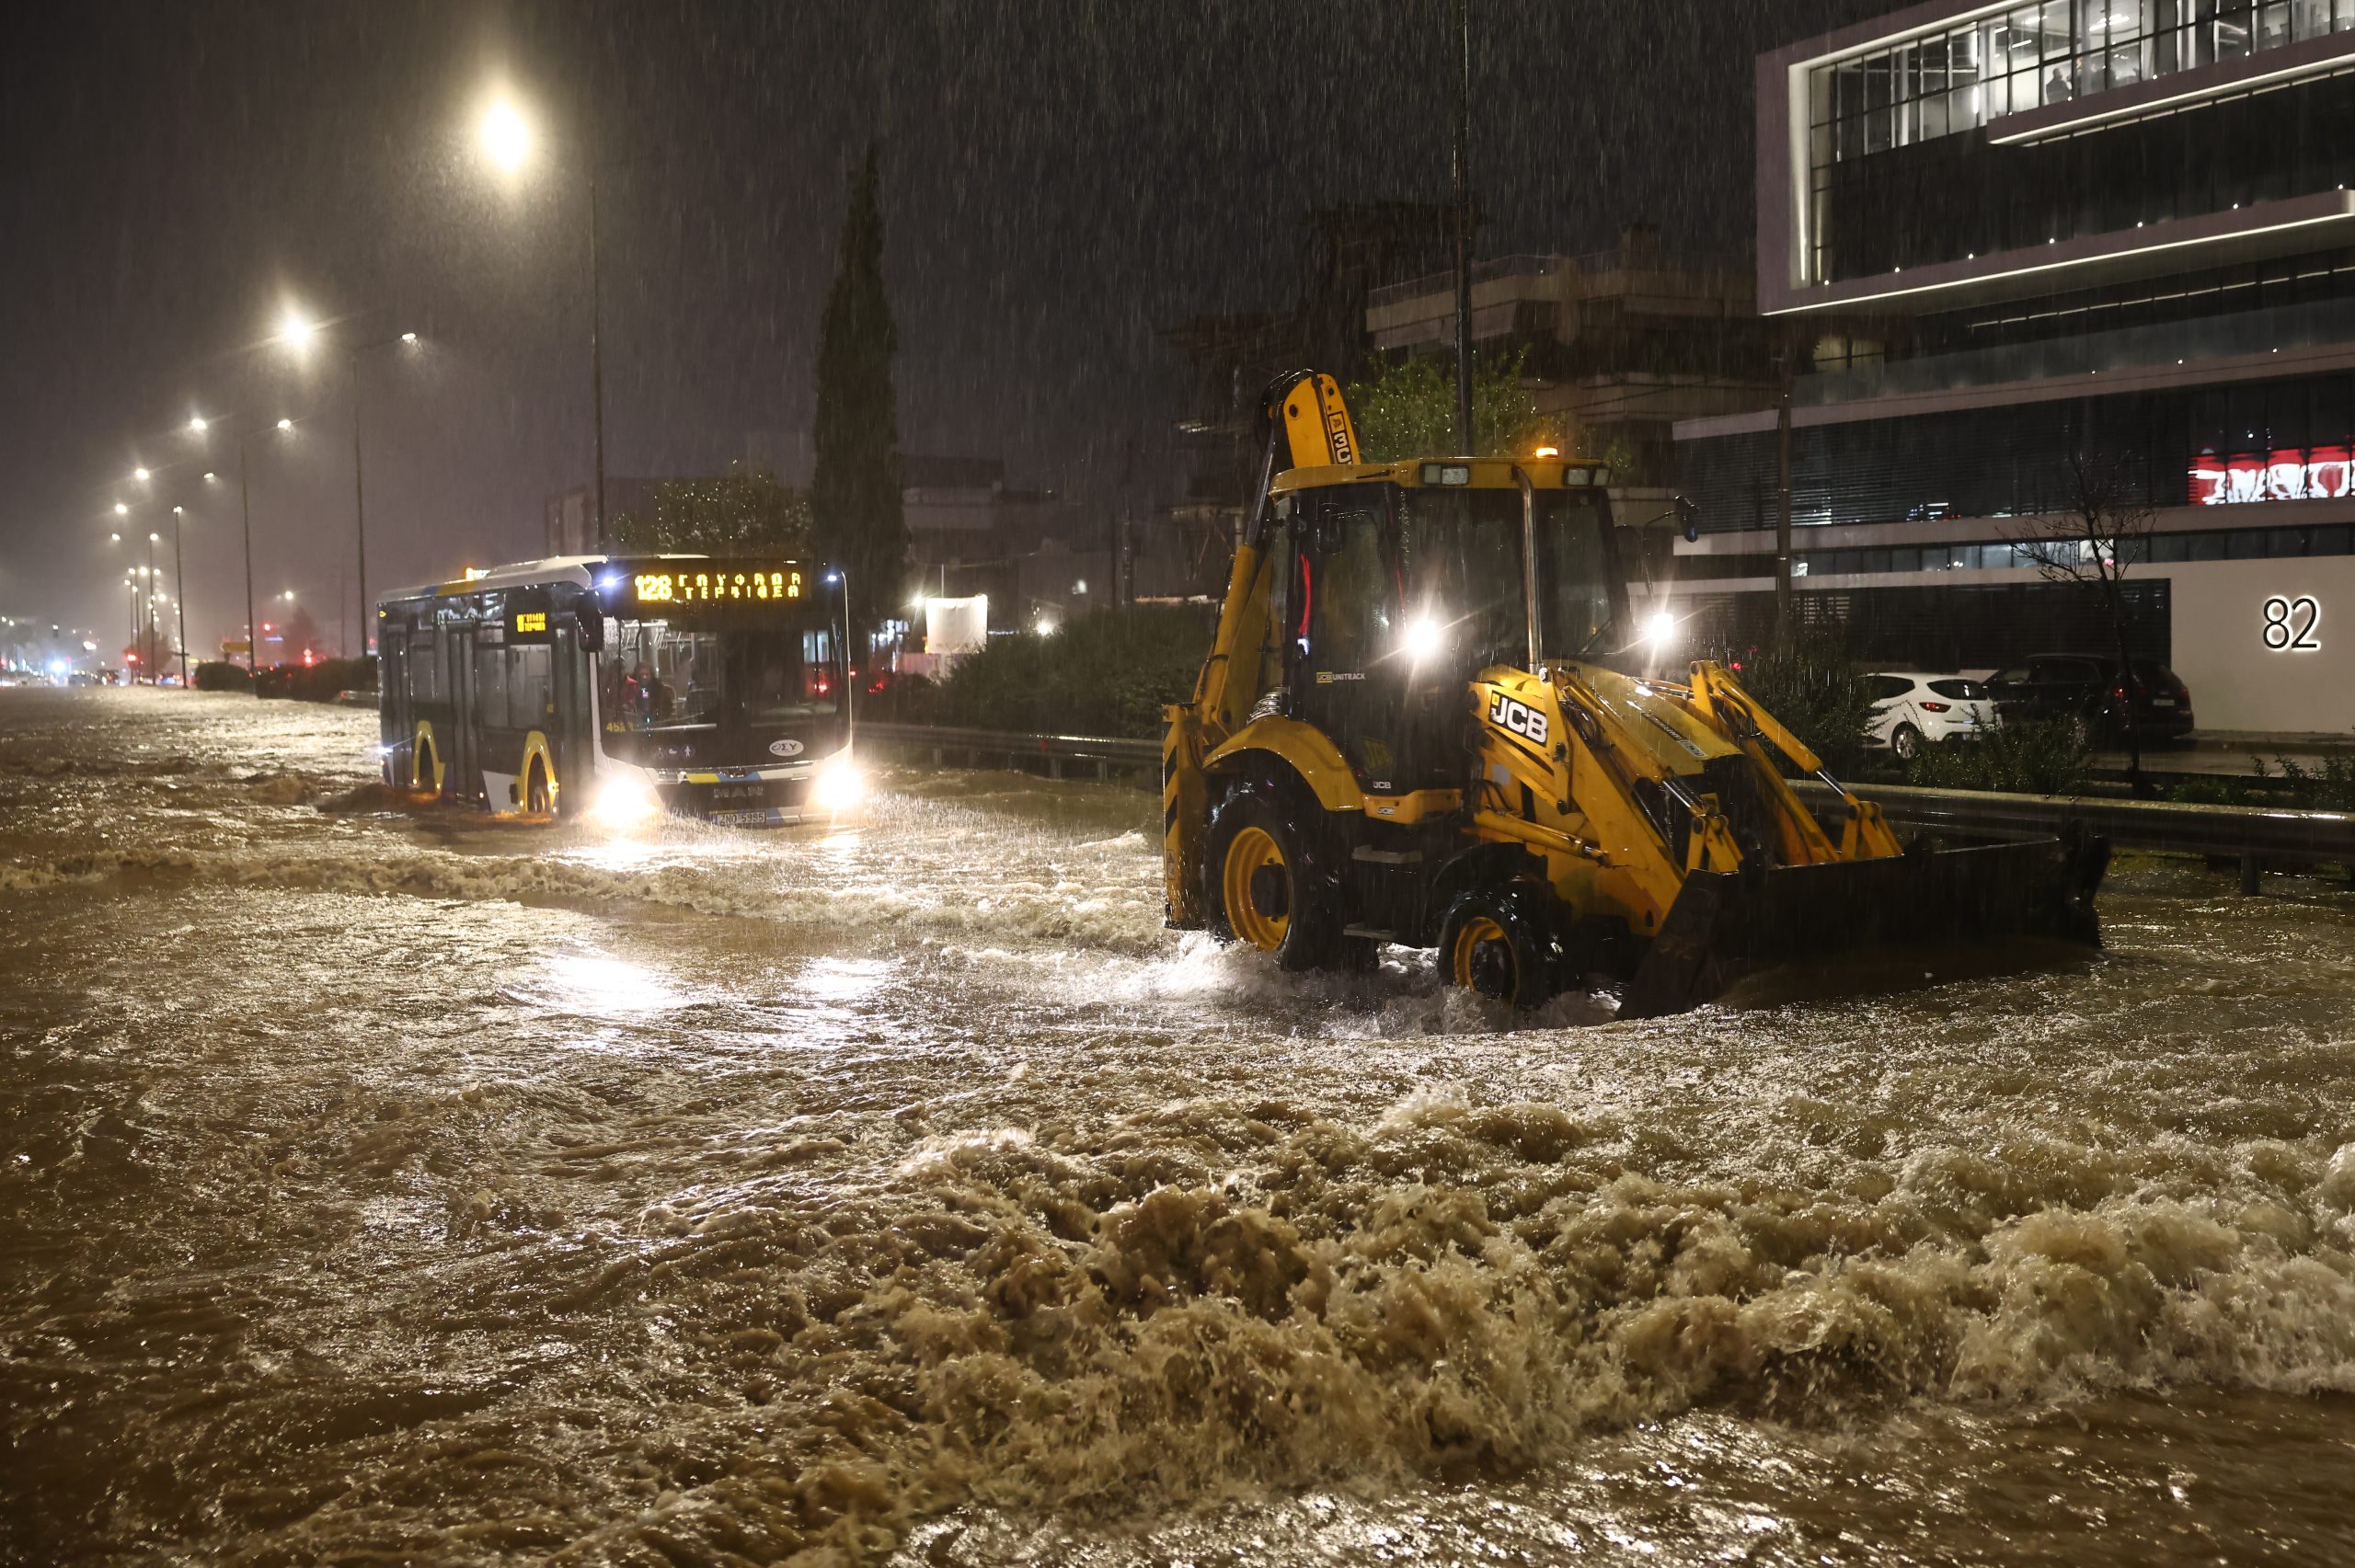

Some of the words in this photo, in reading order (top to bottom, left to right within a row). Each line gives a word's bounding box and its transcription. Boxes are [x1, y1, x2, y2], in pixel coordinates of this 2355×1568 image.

[1333, 432, 1352, 464] 3C
[635, 575, 672, 600] 128
[2263, 598, 2317, 648] 82
[1490, 697, 1547, 743] JCB
